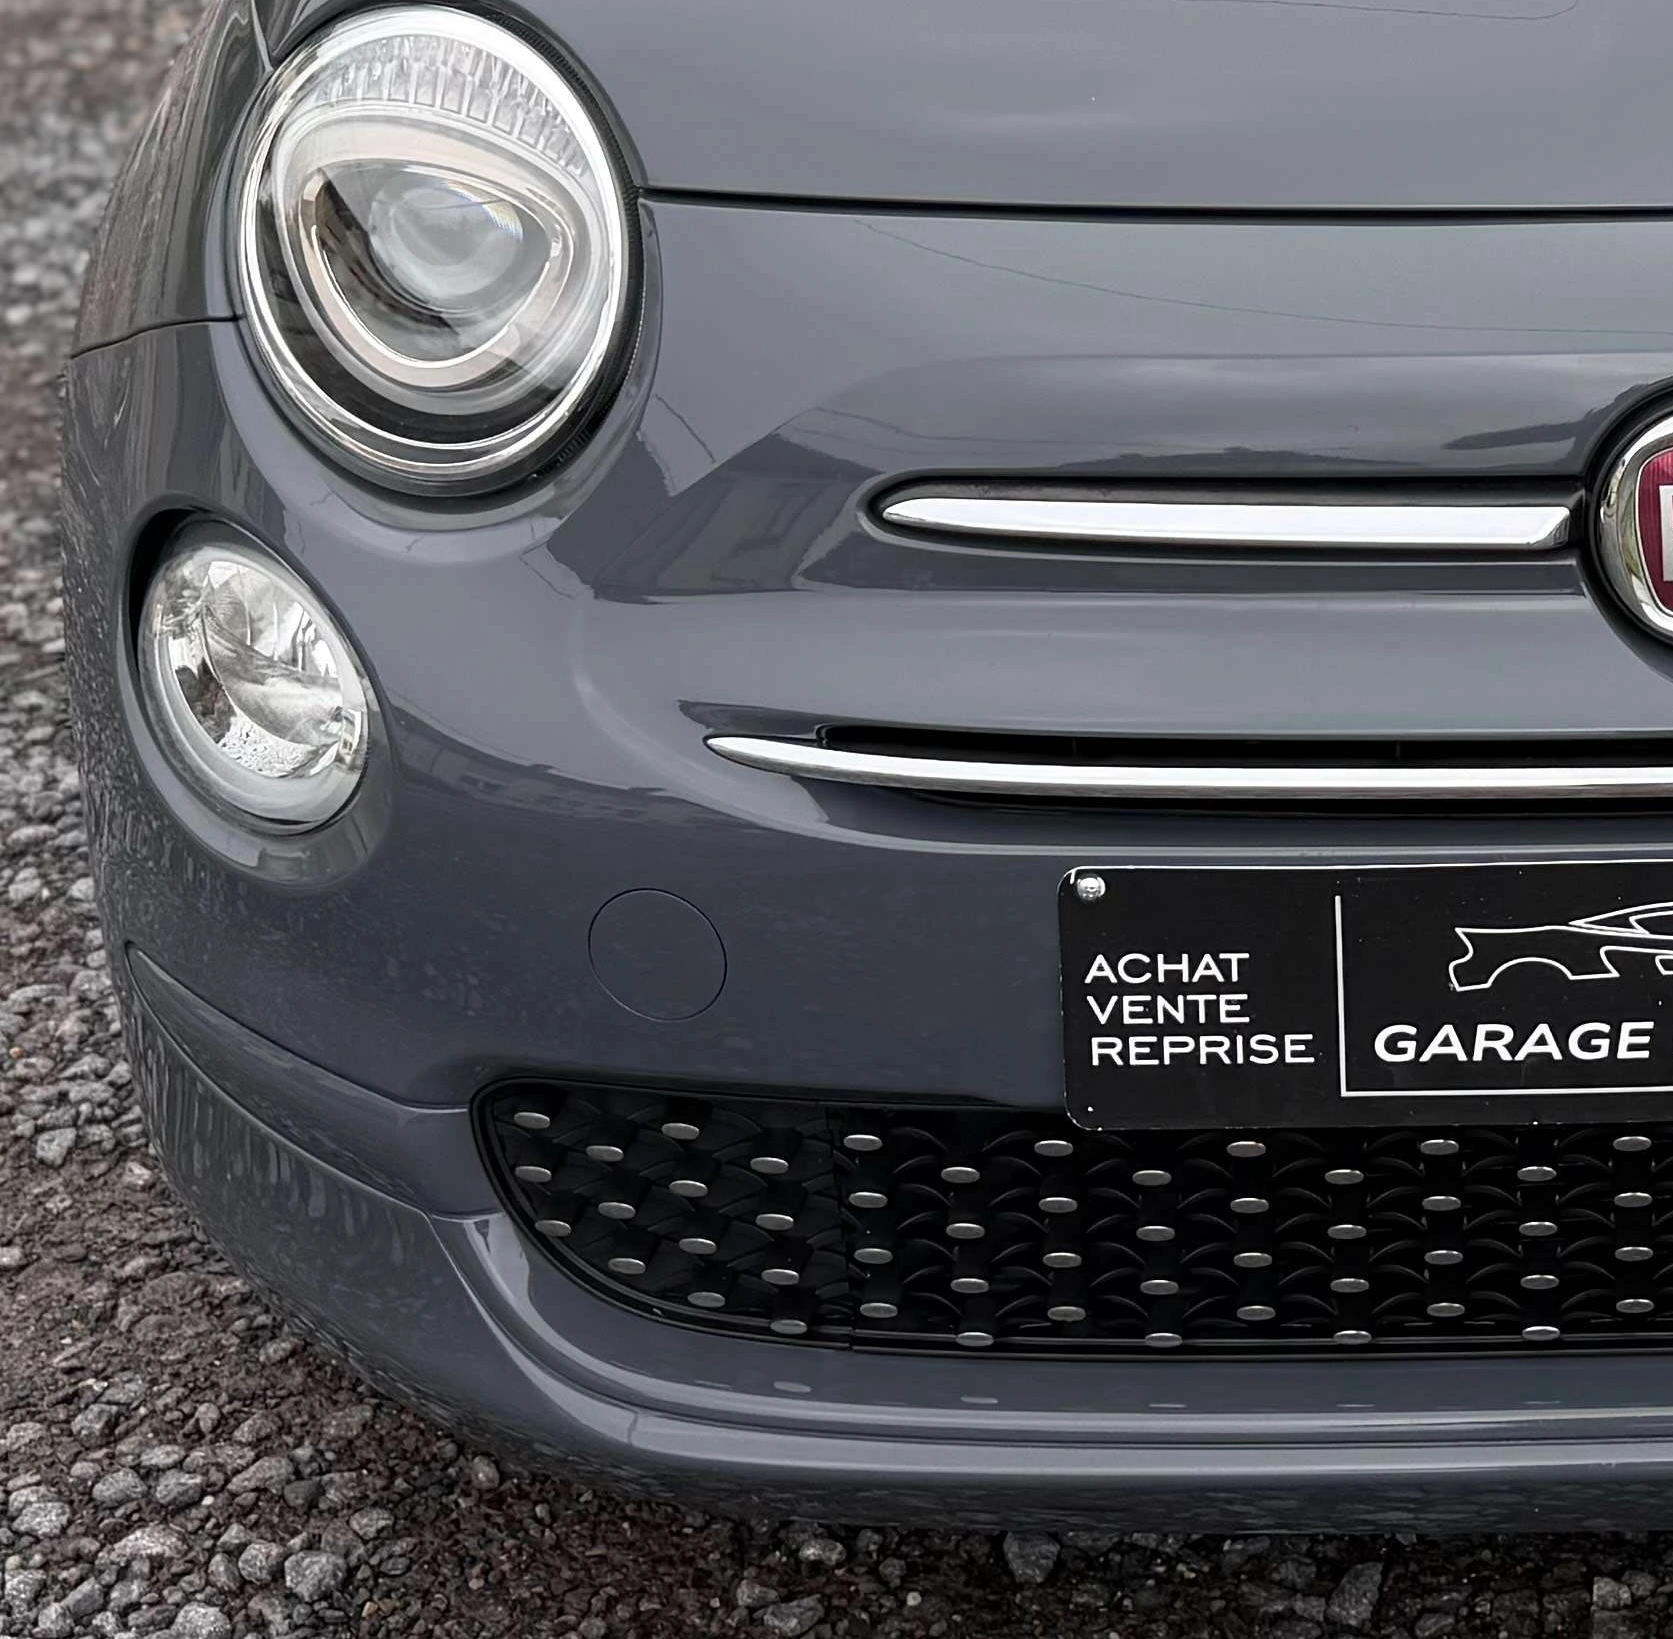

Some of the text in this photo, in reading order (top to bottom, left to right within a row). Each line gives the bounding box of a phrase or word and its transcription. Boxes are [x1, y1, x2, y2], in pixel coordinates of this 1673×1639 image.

[1084, 953, 1250, 984] ACHAT
[1086, 994, 1250, 1024] VENTE
[1091, 1034, 1315, 1065] REPRISE
[1374, 1021, 1654, 1062] GARAGE
